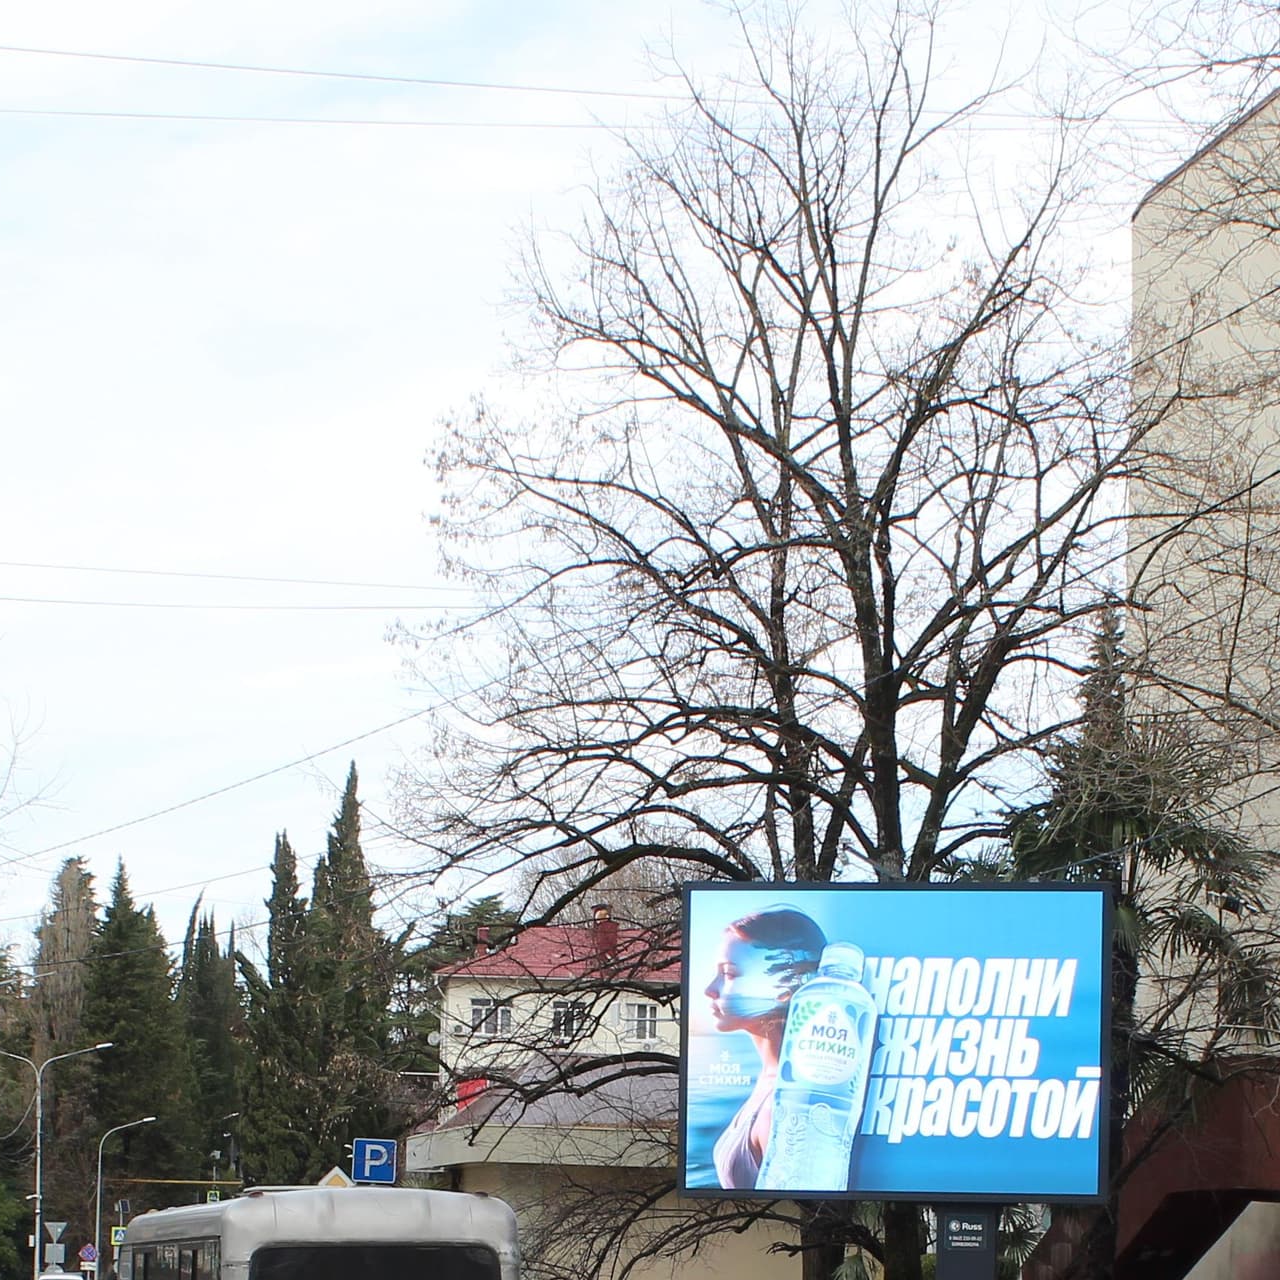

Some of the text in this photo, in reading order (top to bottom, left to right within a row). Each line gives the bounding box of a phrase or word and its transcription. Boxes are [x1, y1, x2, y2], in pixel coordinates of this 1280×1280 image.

[863, 957, 1078, 1017] наполни
[811, 1025, 848, 1042] МОЯ
[798, 1040, 856, 1059] СТИХИЯ
[870, 1018, 1040, 1077] жизнь
[710, 1063, 740, 1074] МОЯ
[860, 1066, 1102, 1143] красотой
[962, 1222, 983, 1231] Russ
